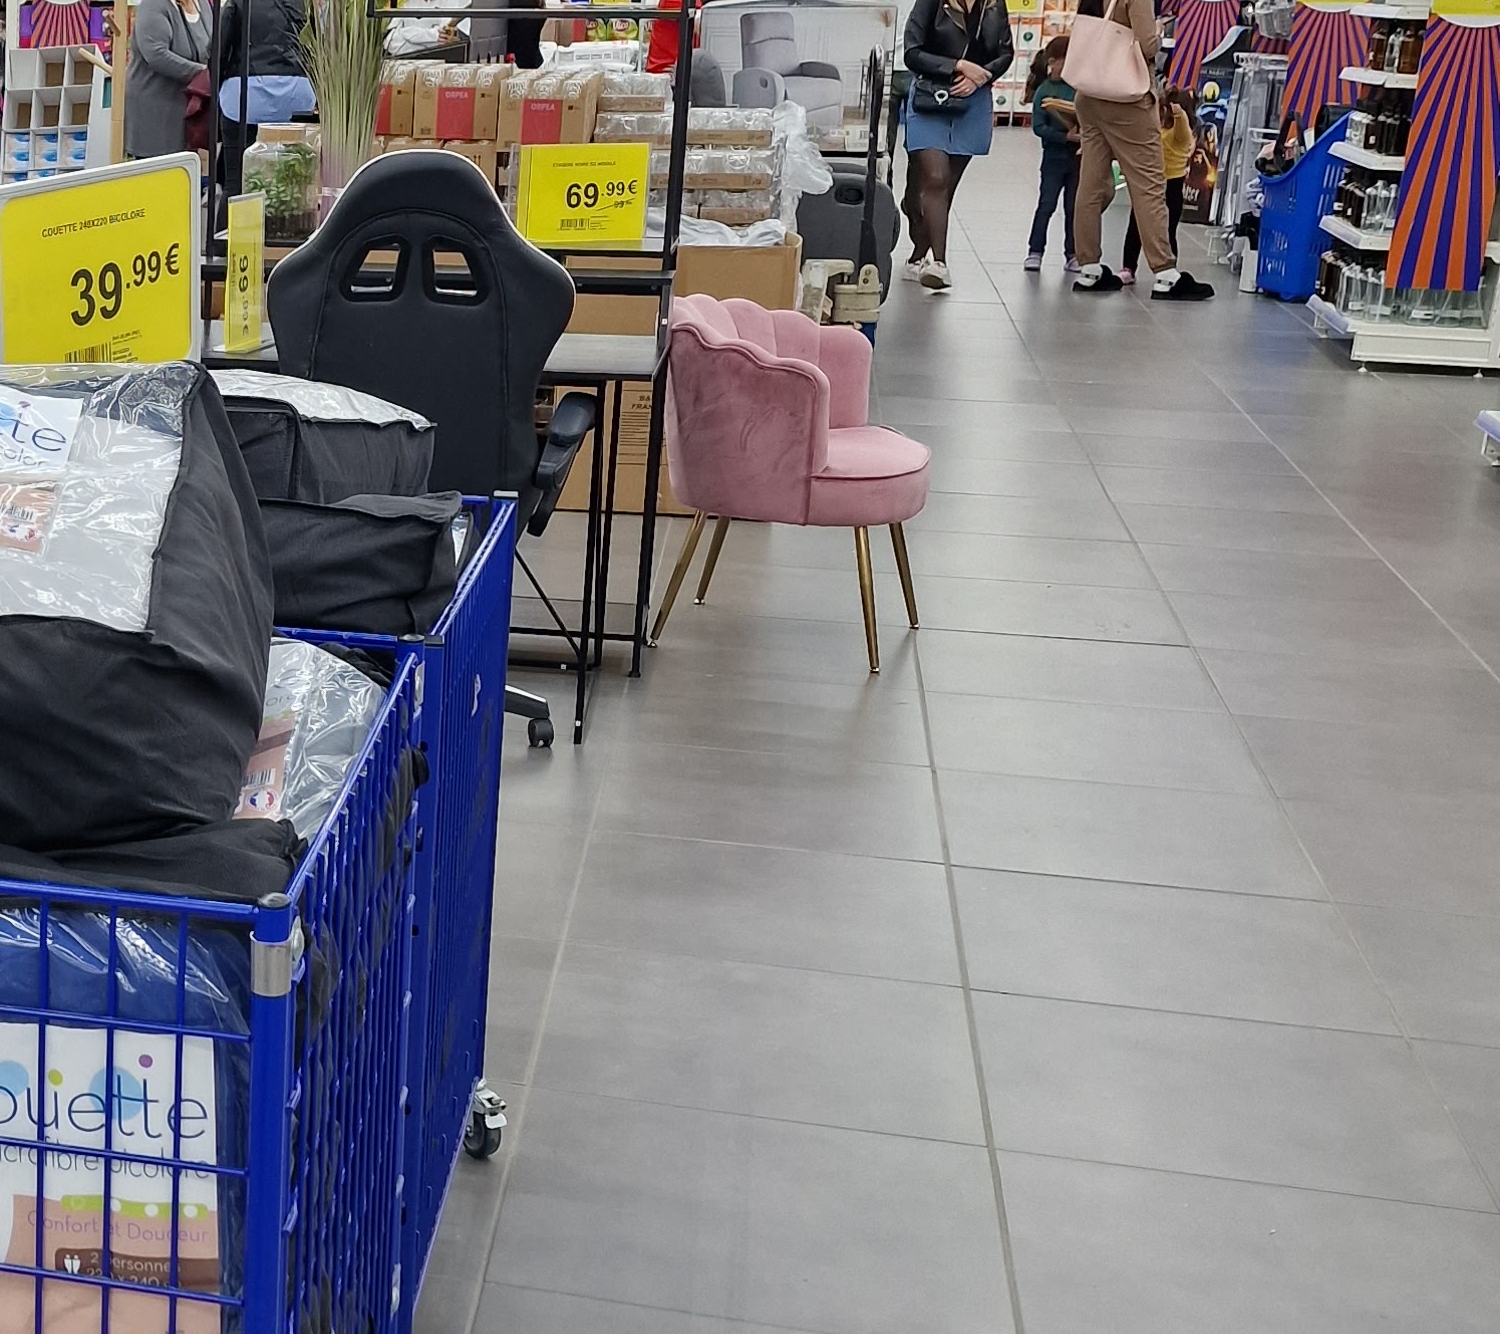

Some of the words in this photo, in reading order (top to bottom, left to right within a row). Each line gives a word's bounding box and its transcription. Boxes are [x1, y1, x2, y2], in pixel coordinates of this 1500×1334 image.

[566, 180, 638, 208] 69.99€
[42, 222, 78, 238] COUETTE
[109, 208, 147, 224] BICOLORE
[70, 243, 180, 327] 39.99€
[28, 1211, 98, 1234] Confort
[90, 1251, 99, 1264] 2
[109, 1257, 182, 1274] ersonne
